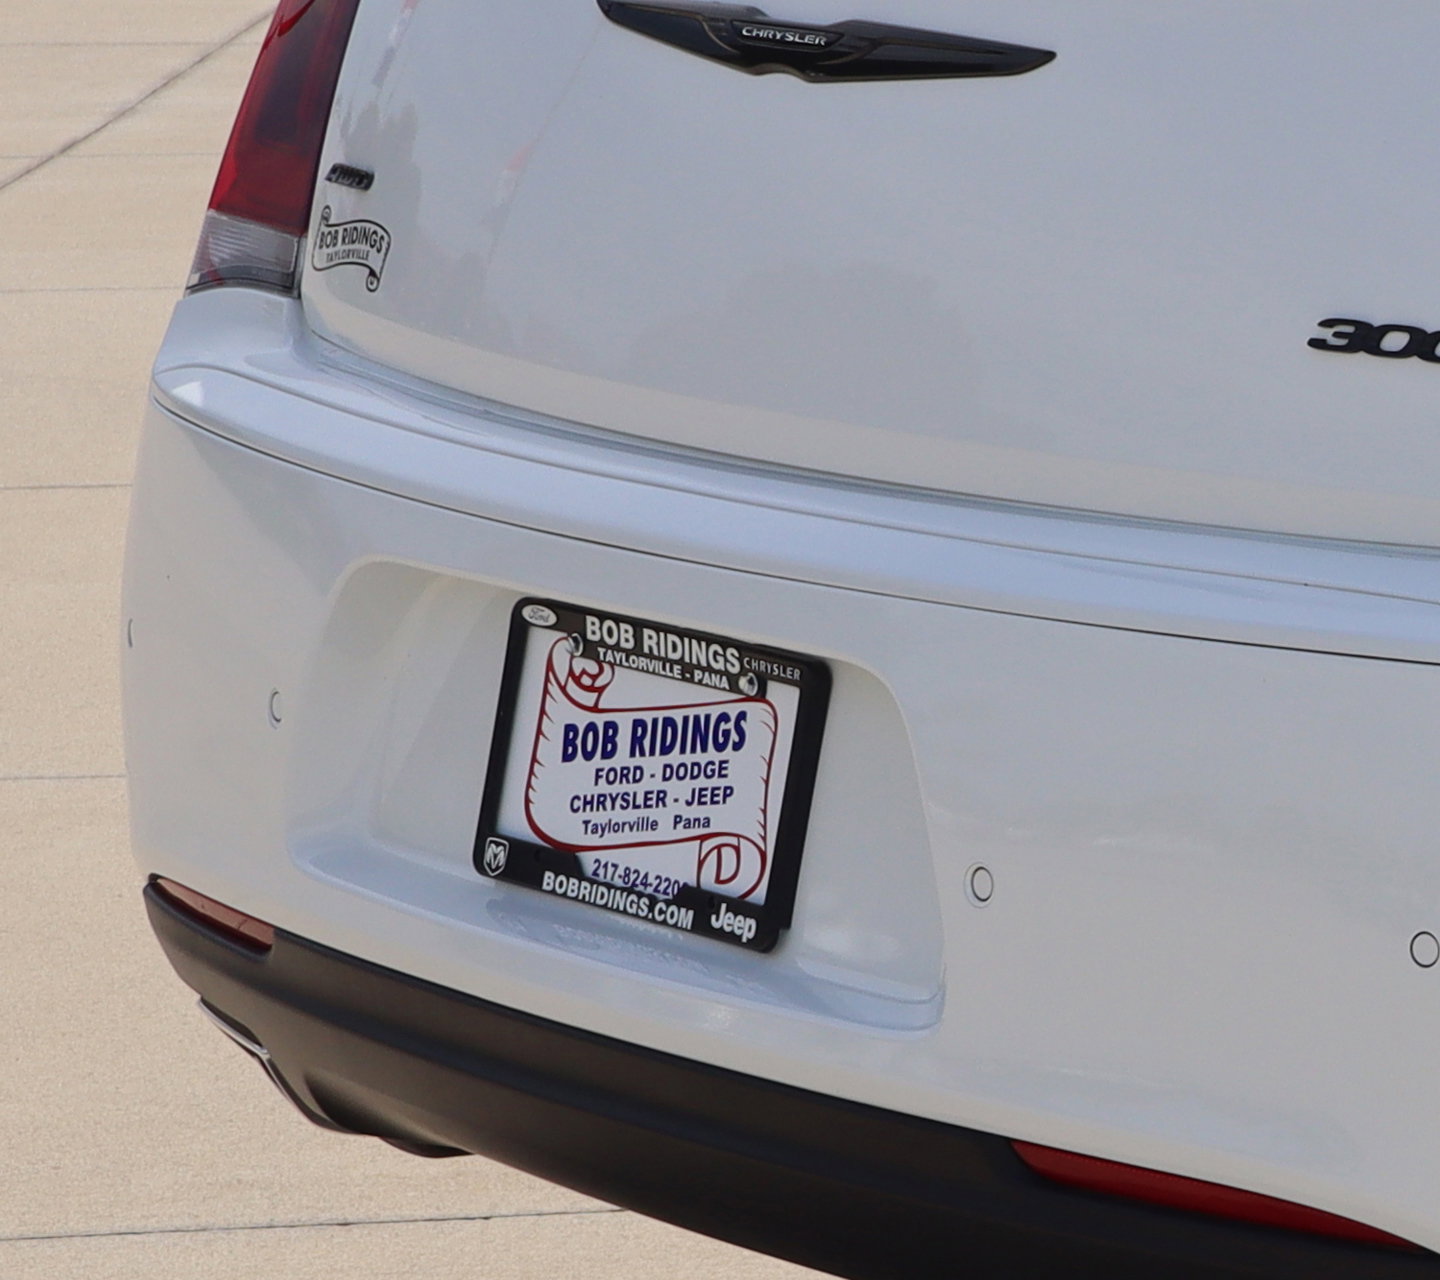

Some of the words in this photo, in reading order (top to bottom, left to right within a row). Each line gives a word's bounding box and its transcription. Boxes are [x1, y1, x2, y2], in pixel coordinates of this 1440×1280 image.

[742, 26, 827, 46] CHRYSLER
[318, 229, 340, 250] BOB
[341, 225, 385, 254] RIDINGS
[326, 249, 371, 263] TAYLORVILLE
[585, 615, 635, 650] BOB
[642, 627, 741, 675] RIDINGS
[597, 647, 682, 680] TAYLORVILLE
[694, 669, 730, 691] PANA
[743, 657, 801, 681] CHRYSLER
[561, 721, 619, 763] BOB
[629, 710, 748, 758] RIDINGS
[594, 765, 645, 787] FORD
[662, 760, 730, 782] DODGE
[569, 789, 668, 814] CHRYSLER
[685, 785, 735, 807] JEEP
[582, 816, 659, 839] Taylorville
[673, 814, 711, 831] Pana
[542, 871, 694, 930] BOBRIDINGS.COM
[710, 903, 757, 943] Jeep
